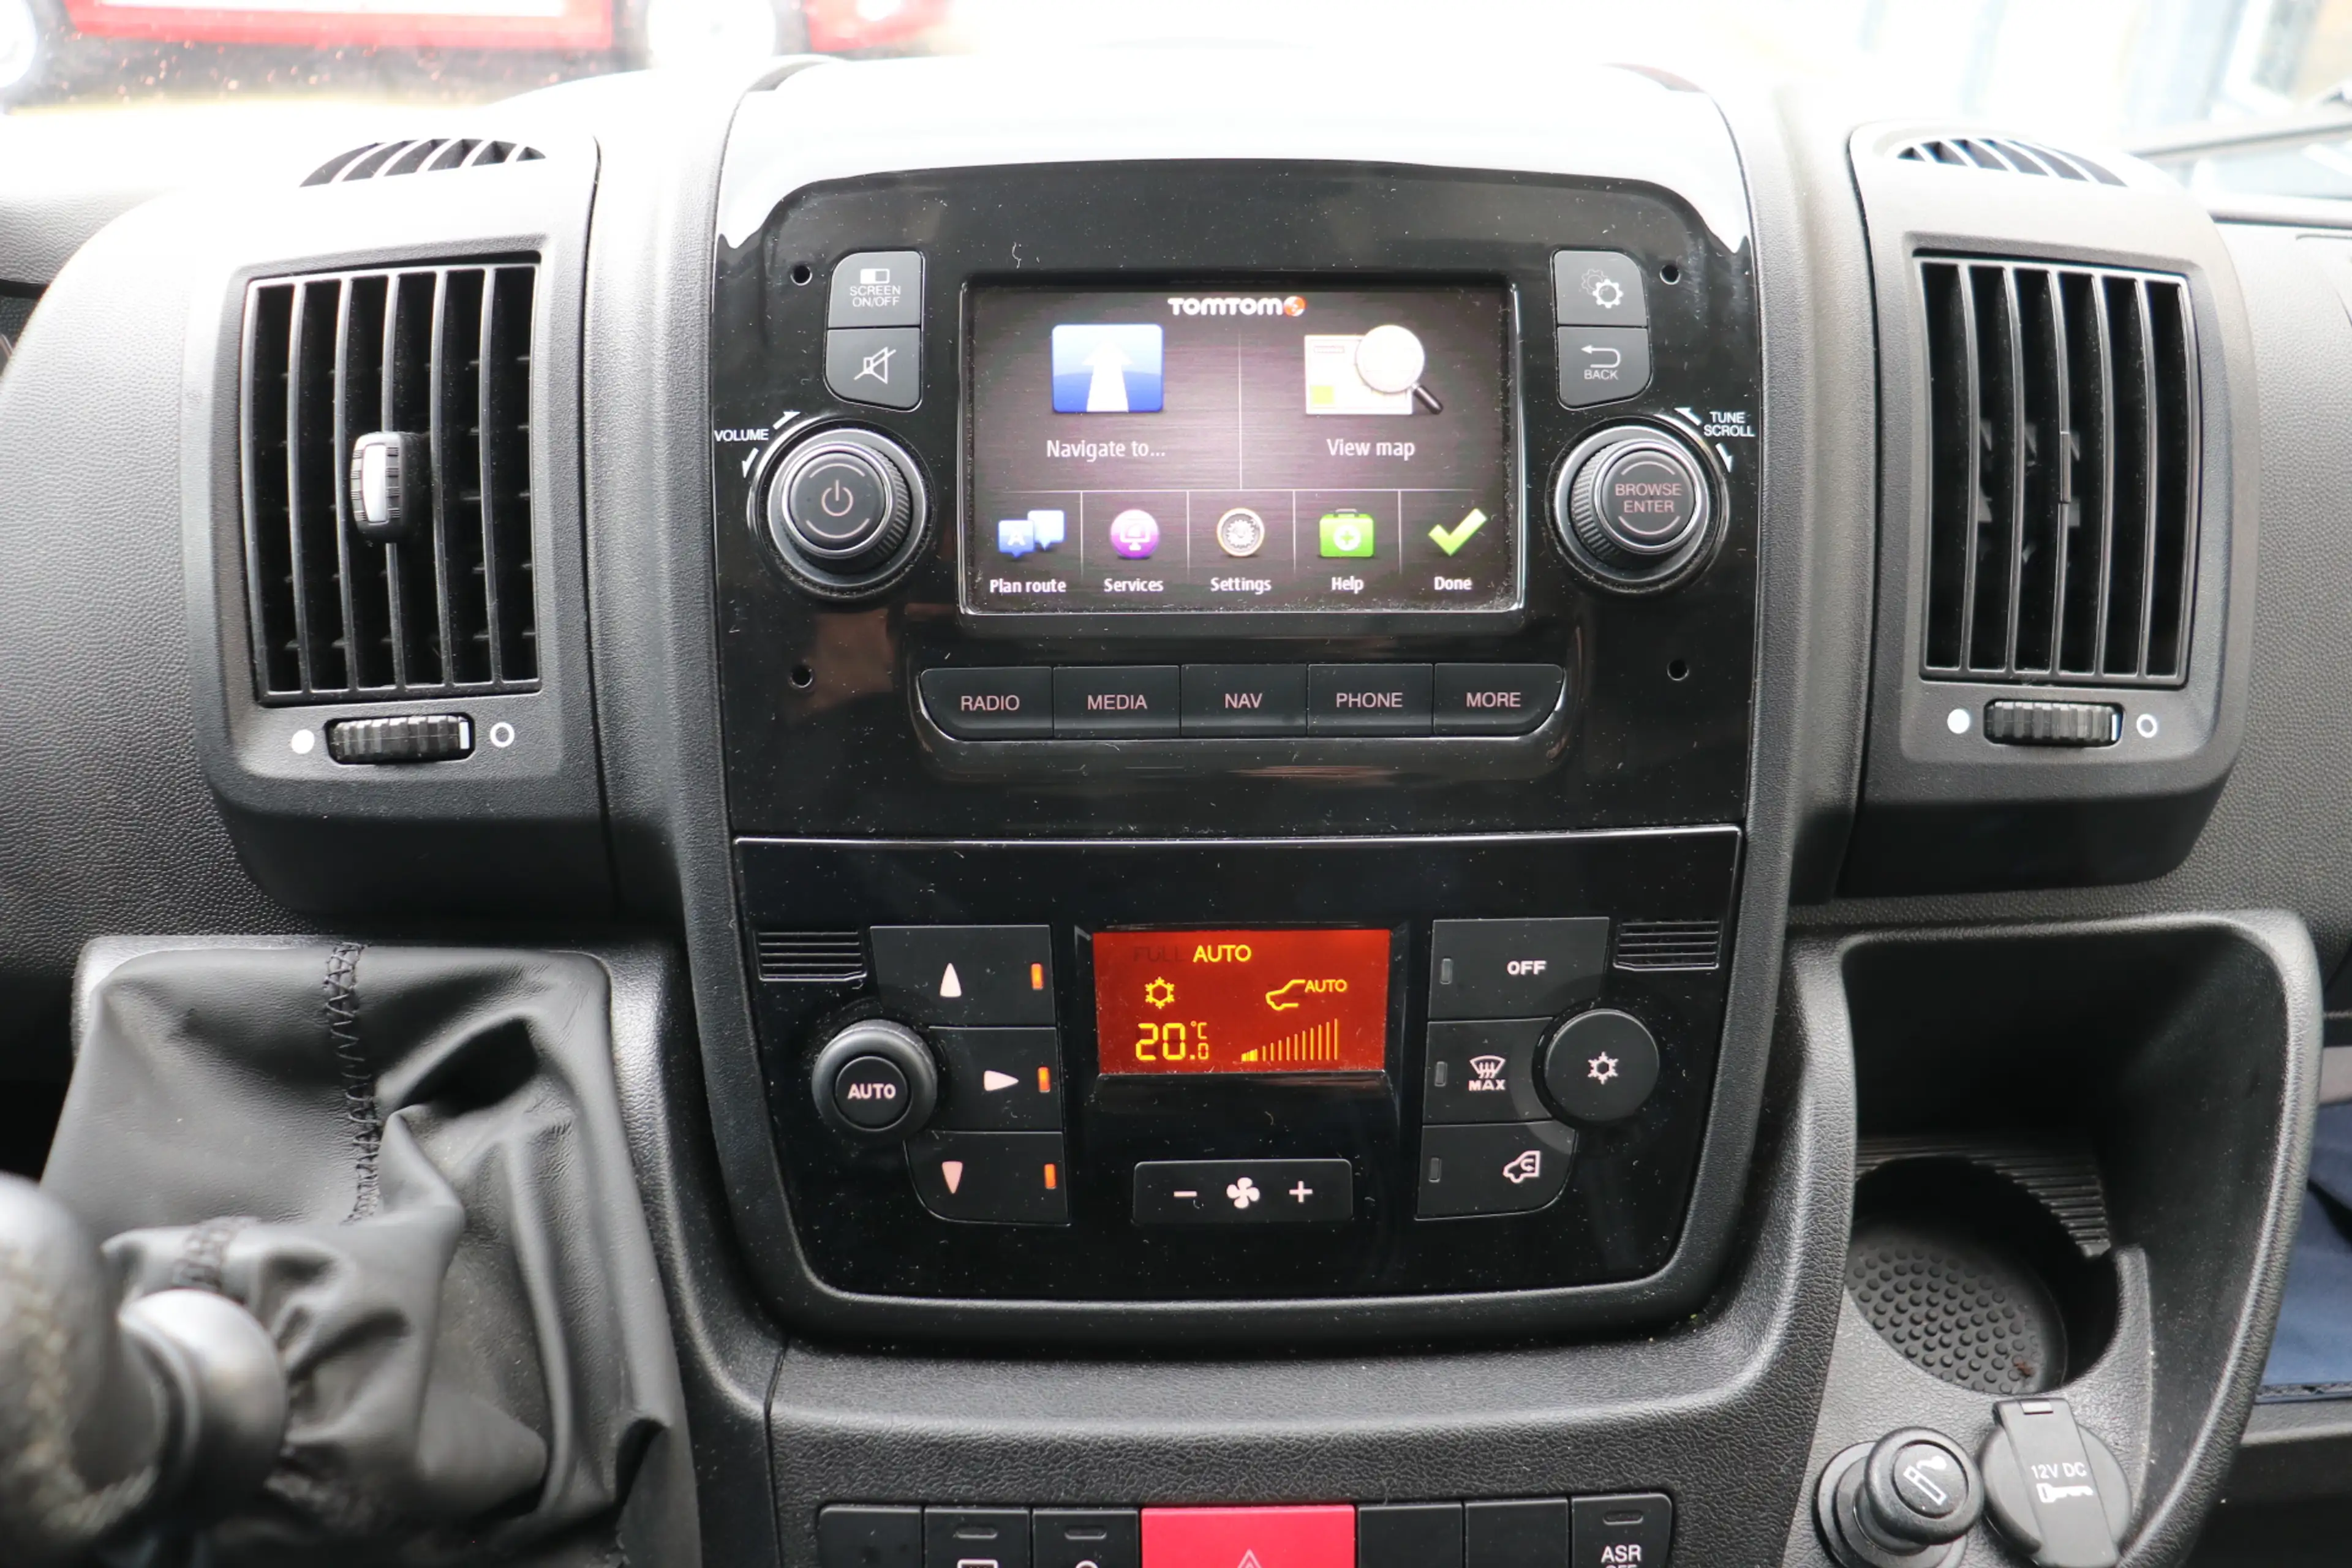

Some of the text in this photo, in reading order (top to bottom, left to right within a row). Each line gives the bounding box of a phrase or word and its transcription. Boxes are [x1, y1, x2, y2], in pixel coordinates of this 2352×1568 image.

[850, 285, 902, 295] SCREEN
[852, 296, 900, 307] ON/OFF
[1584, 369, 1619, 380] BACK
[1709, 412, 1746, 423] TUNE
[714, 429, 769, 442] VOLUME
[1703, 424, 1755, 437] SCROLL
[1046, 439, 1166, 462] Navigate to...
[1326, 438, 1415, 461] View map
[1615, 484, 1682, 497] BROWSE
[1623, 500, 1675, 513] ENTER
[989, 578, 1066, 594] Plan route
[1104, 578, 1164, 593] Services
[1210, 576, 1272, 595] Settings
[1331, 575, 1365, 595] Help
[1434, 576, 1472, 592] Done
[960, 695, 1020, 711] RADIO
[1087, 695, 1148, 710] MEDIA
[1224, 693, 1264, 709] NAV
[1335, 692, 1403, 708] PHONE
[1466, 692, 1521, 707] MORE
[1193, 944, 1252, 963] AUTO
[1507, 960, 1547, 975] OFF
[1305, 979, 1348, 993] AUTO
[847, 1083, 896, 1099] AUTO
[1468, 1079, 1506, 1091] MAX
[2031, 1463, 2086, 1480] 12V DC
[1600, 1544, 1642, 1564] ASR
